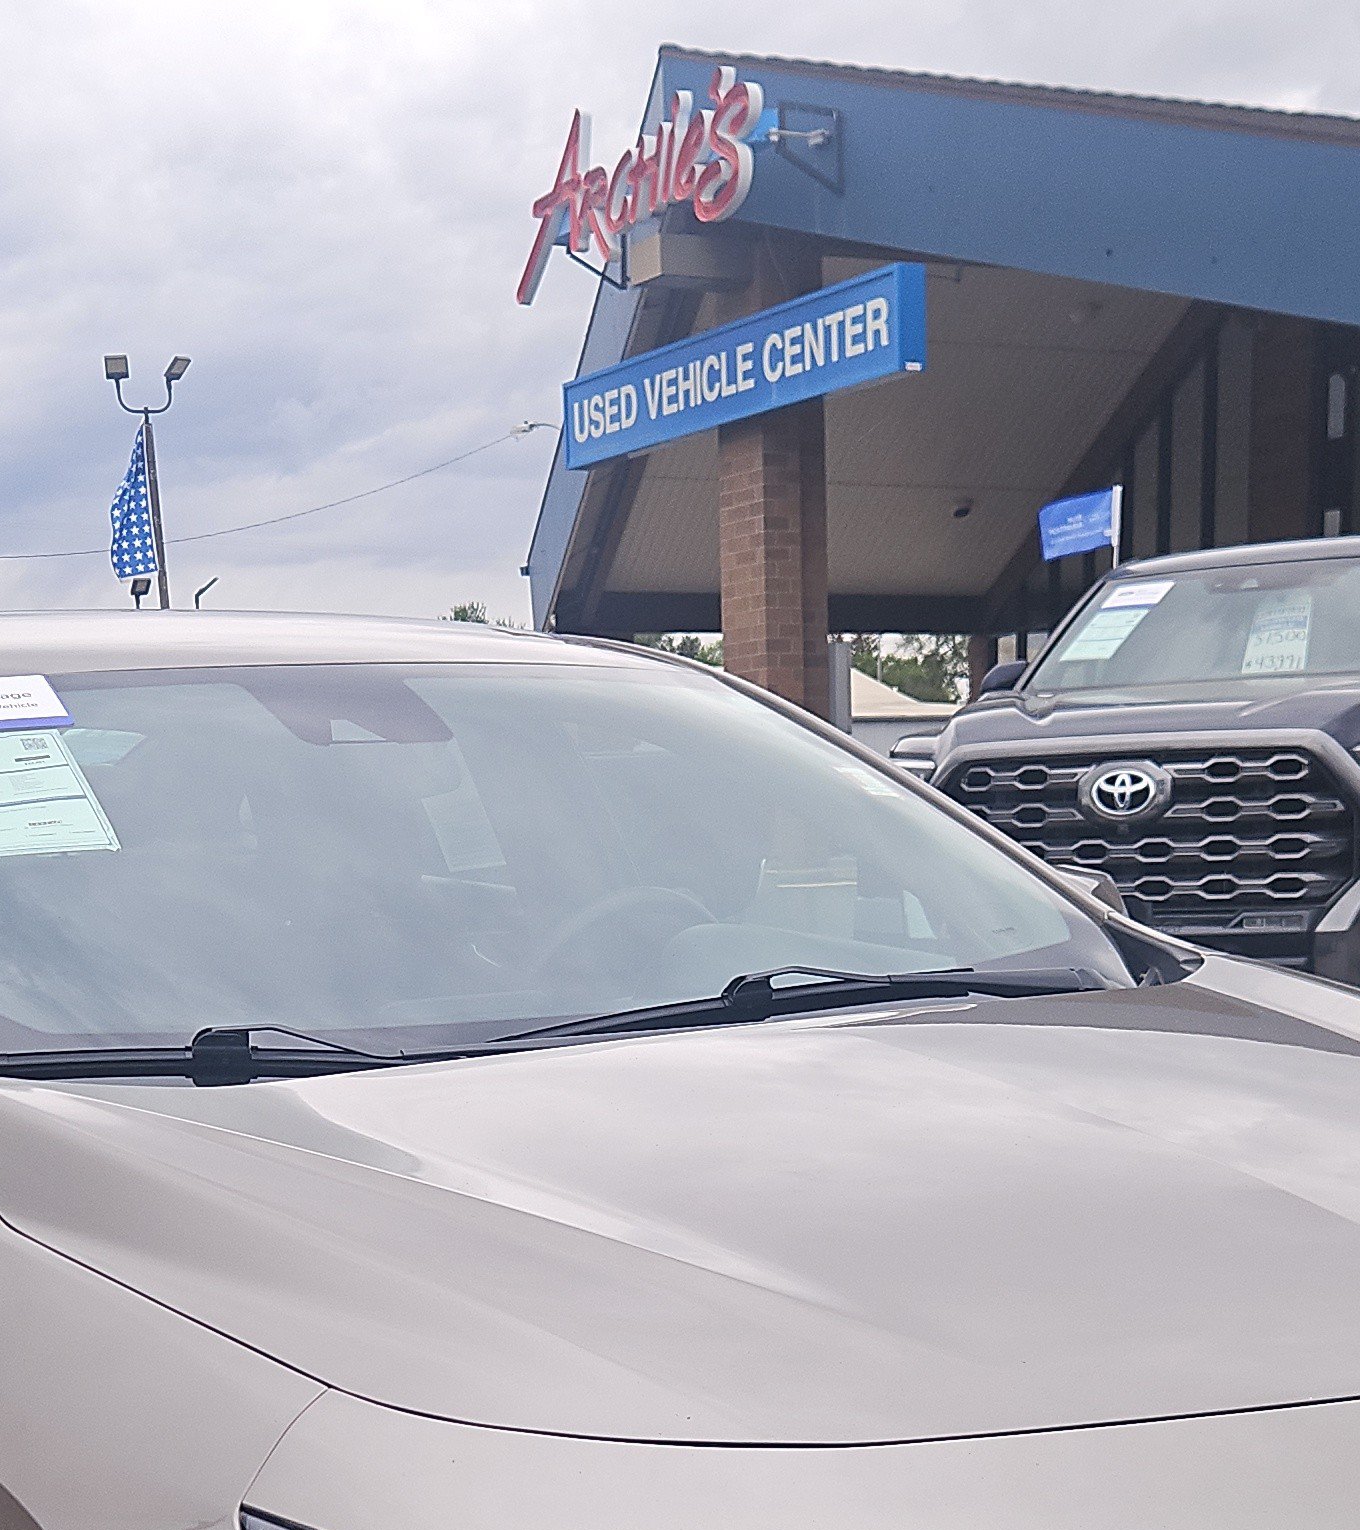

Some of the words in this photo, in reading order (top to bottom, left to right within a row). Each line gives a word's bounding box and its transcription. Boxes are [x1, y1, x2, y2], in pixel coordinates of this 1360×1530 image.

[573, 384, 637, 443] USED
[643, 342, 755, 420] VEHICLE
[761, 297, 890, 383] CENTER
